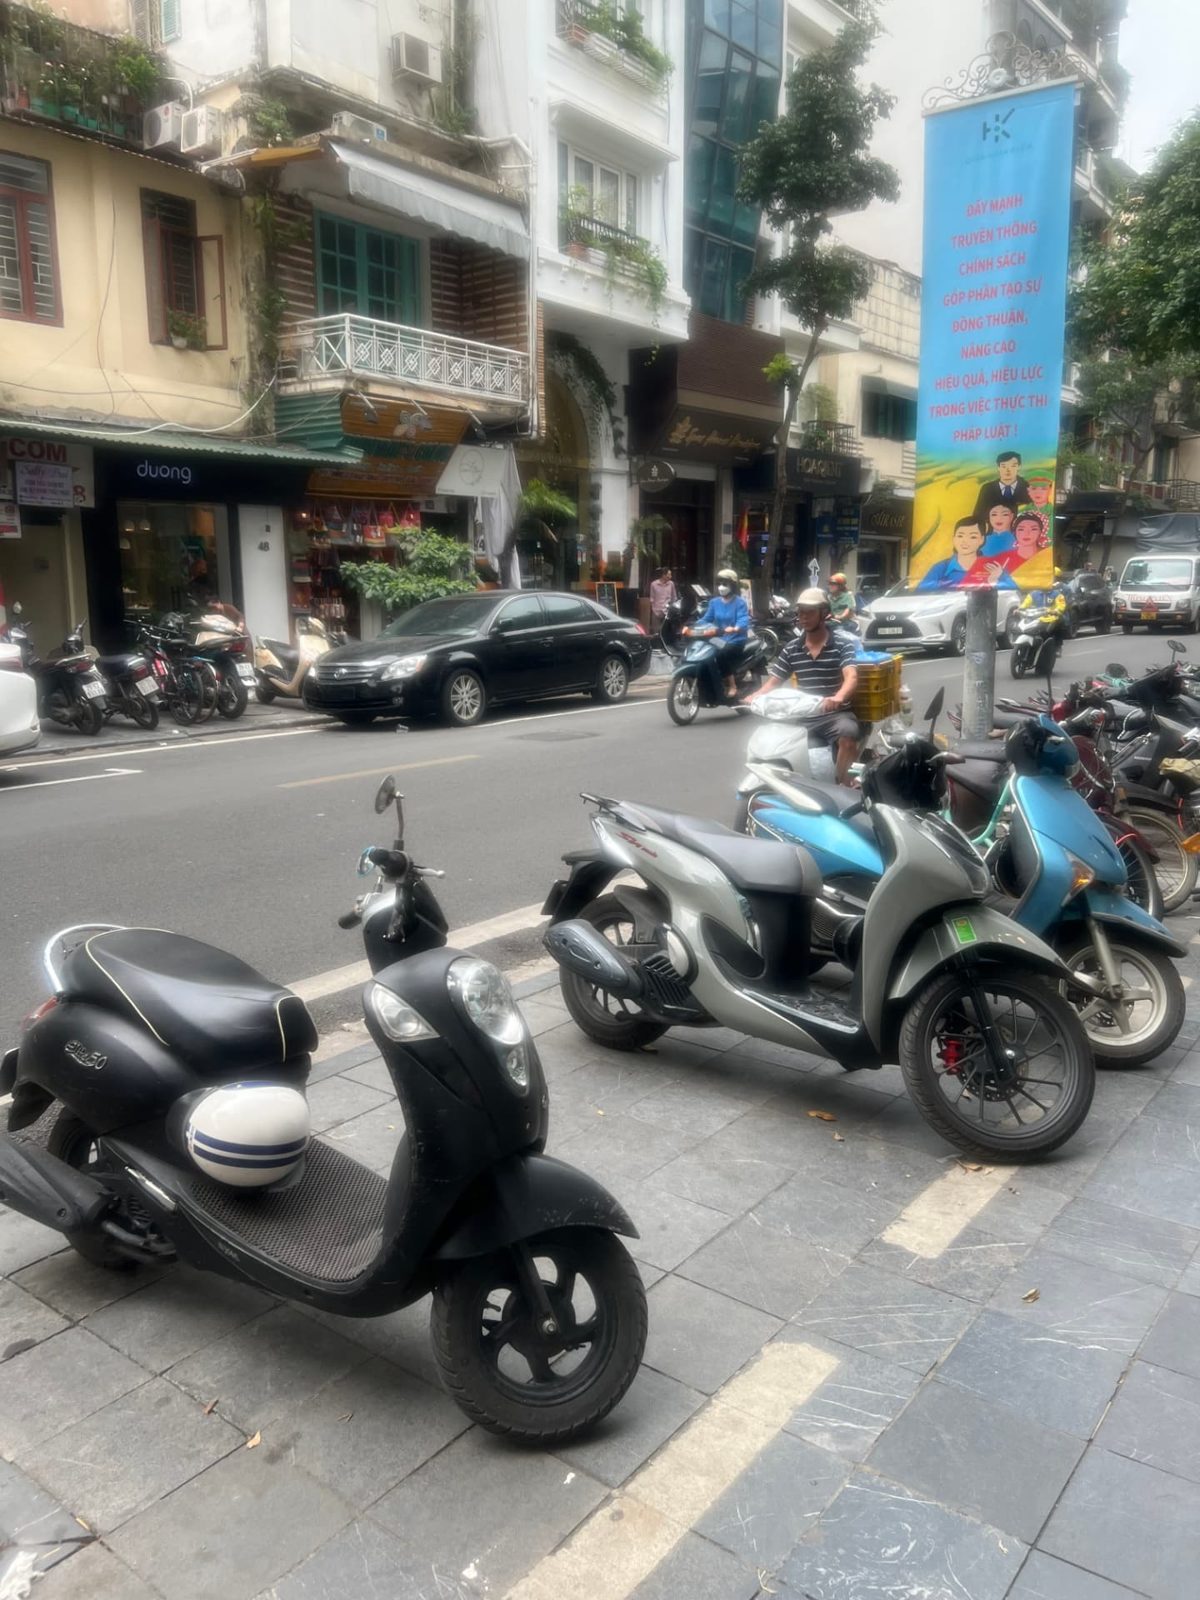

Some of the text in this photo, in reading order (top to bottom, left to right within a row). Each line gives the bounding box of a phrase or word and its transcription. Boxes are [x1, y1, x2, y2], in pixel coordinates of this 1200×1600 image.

[992, 340, 1016, 354] CAO
[929, 405, 964, 418] TRONG
[1027, 395, 1047, 408] THI
[136, 460, 192, 484] duong
[258, 541, 270, 552] 48
